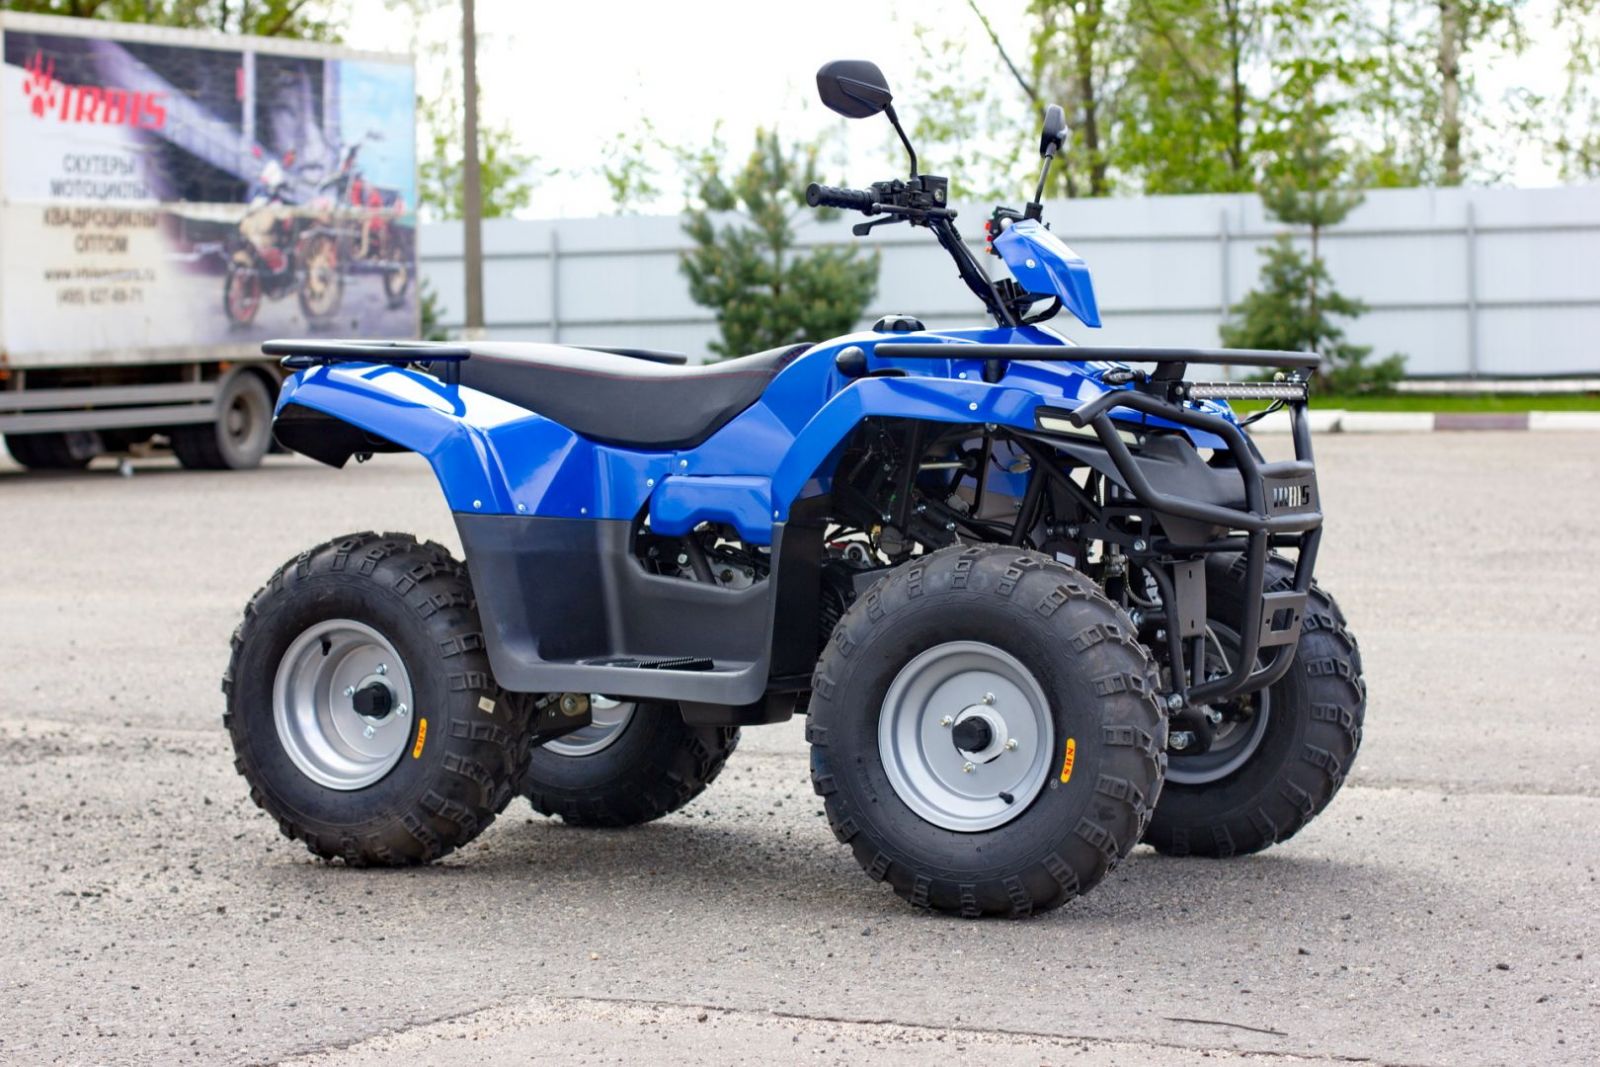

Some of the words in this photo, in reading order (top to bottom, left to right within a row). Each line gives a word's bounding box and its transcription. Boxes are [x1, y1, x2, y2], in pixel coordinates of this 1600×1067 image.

[60, 85, 168, 130] IRBIS
[62, 153, 136, 175] СКУТЕРЫ
[74, 234, 128, 254] ОПТОМ
